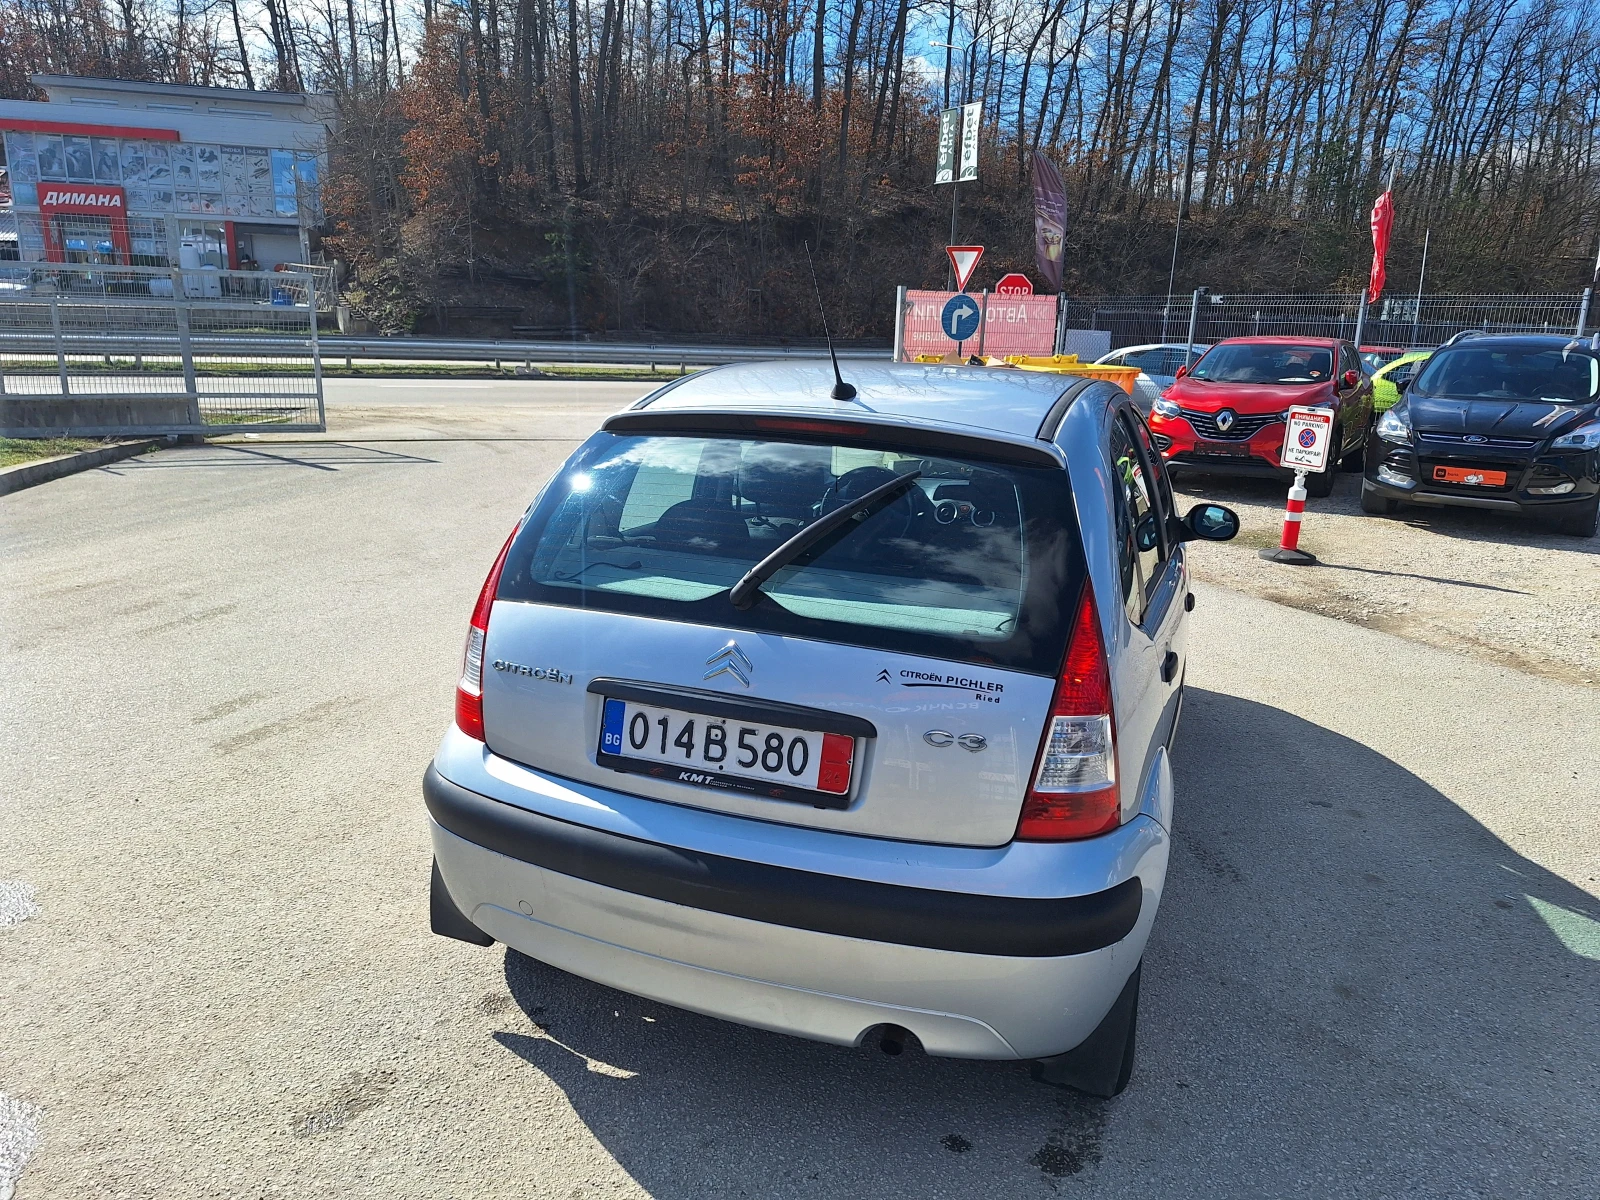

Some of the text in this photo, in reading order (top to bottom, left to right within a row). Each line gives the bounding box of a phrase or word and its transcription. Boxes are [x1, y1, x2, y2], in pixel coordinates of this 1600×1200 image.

[939, 114, 950, 166] efbet
[964, 108, 975, 161] efbet
[42, 191, 121, 207] ДИМАНА
[1000, 286, 1028, 295] STOP
[1295, 414, 1326, 422] ВНИМАНИЕ!
[492, 659, 573, 685] CITROËN
[900, 669, 1004, 693] CITROËN PICHLER
[975, 693, 1000, 704] Ried
[605, 732, 620, 746] BG
[923, 729, 988, 753] C3
[679, 771, 714, 784] KMT
